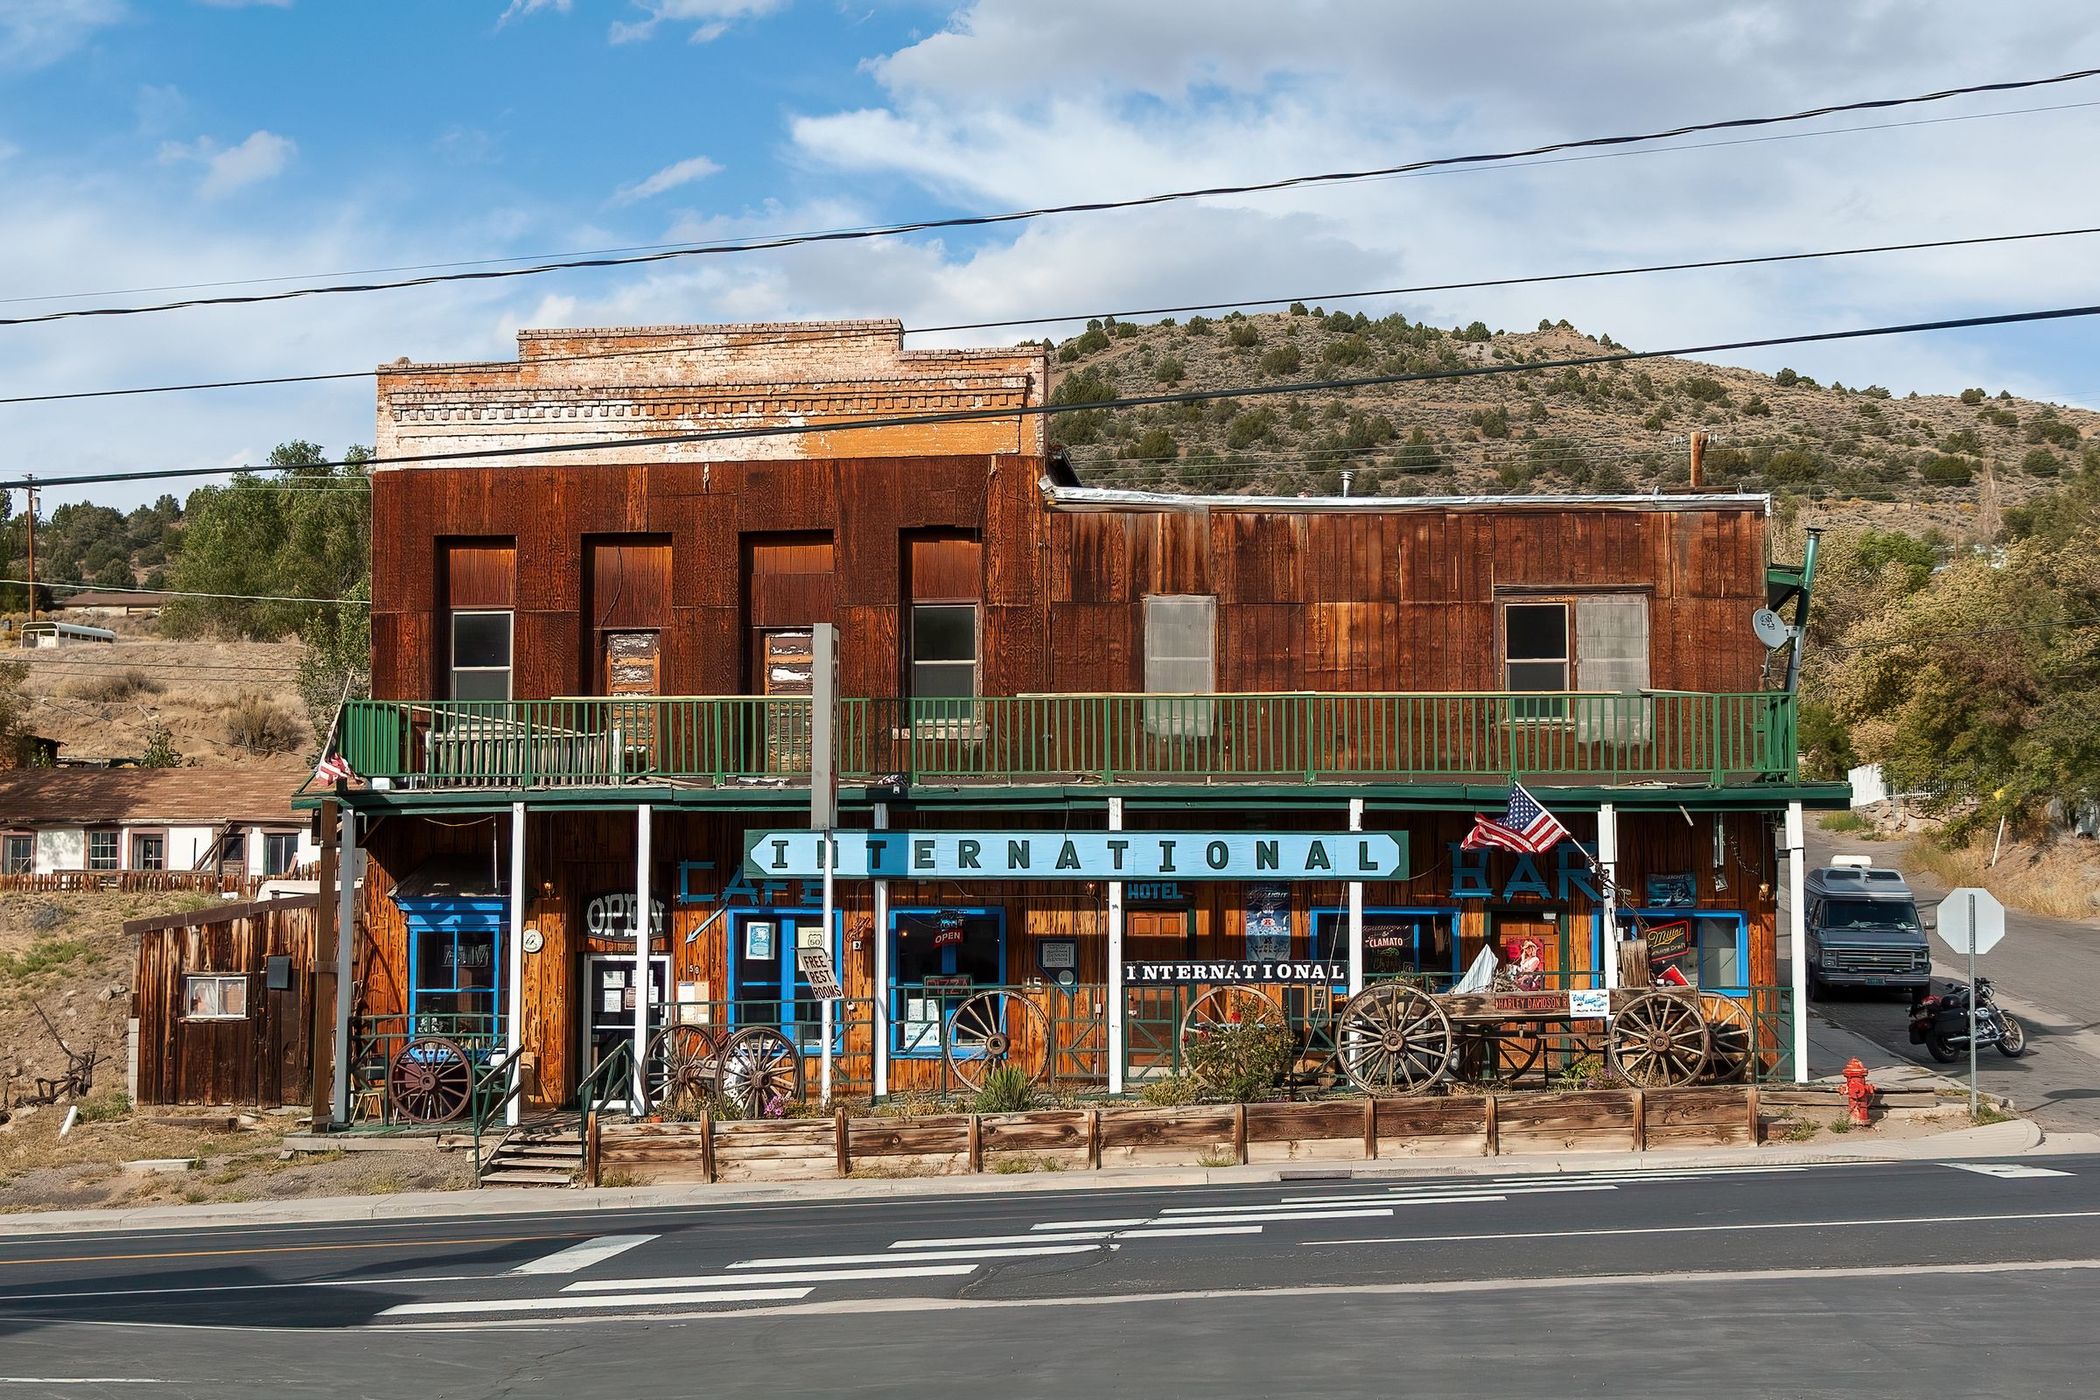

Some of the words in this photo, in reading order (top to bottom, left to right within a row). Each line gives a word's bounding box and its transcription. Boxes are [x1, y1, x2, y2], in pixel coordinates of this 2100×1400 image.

[1448, 841, 1602, 903] BAR
[1128, 882, 1184, 900] HOTEL
[587, 893, 665, 937] OPEN
[935, 931, 961, 944] OPEN
[1369, 937, 1404, 948] CLAMATO
[803, 955, 827, 969] FREE
[810, 970, 832, 984] REST
[1126, 964, 1345, 980] INTERNATIONAL
[813, 984, 842, 1000] ROOMS
[1498, 998, 1525, 1010] HARLEY
